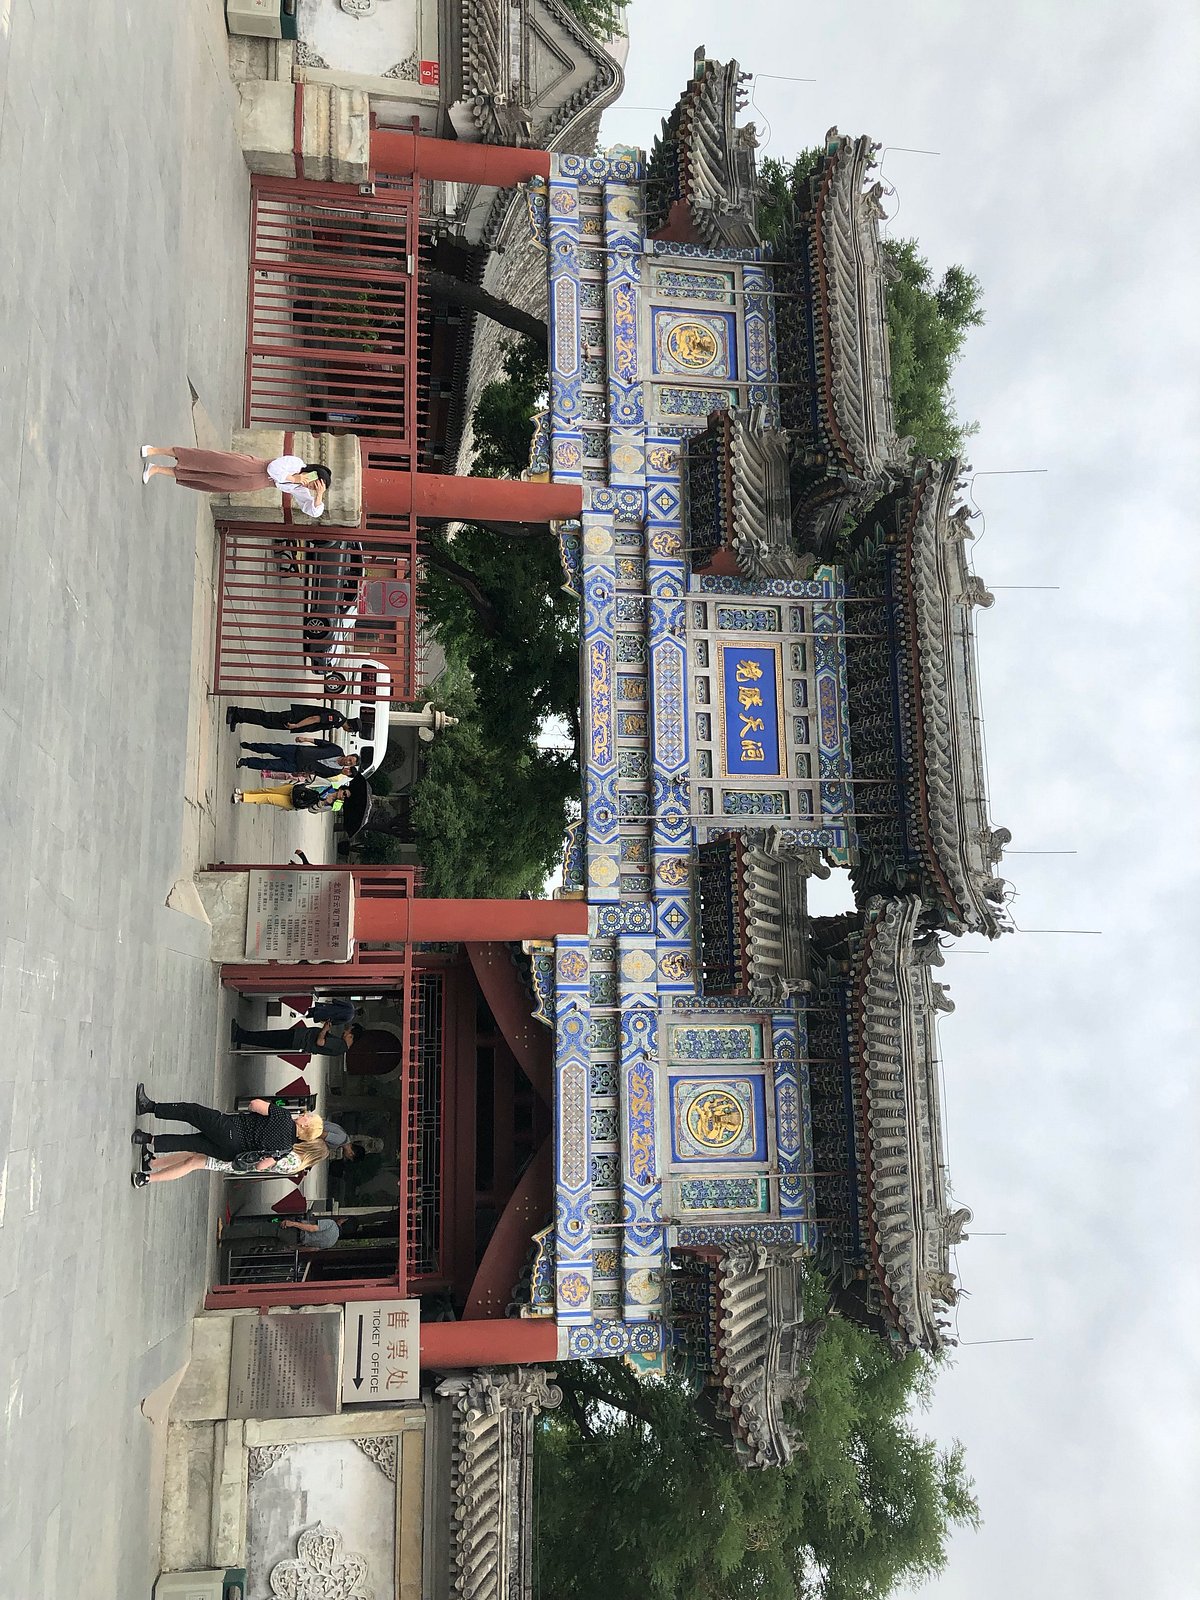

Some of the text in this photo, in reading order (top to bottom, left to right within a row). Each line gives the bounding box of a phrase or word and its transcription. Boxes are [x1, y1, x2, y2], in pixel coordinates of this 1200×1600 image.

[370, 1309, 381, 1393] TICKET OFFICE
[385, 1310, 410, 1391] 售票处
